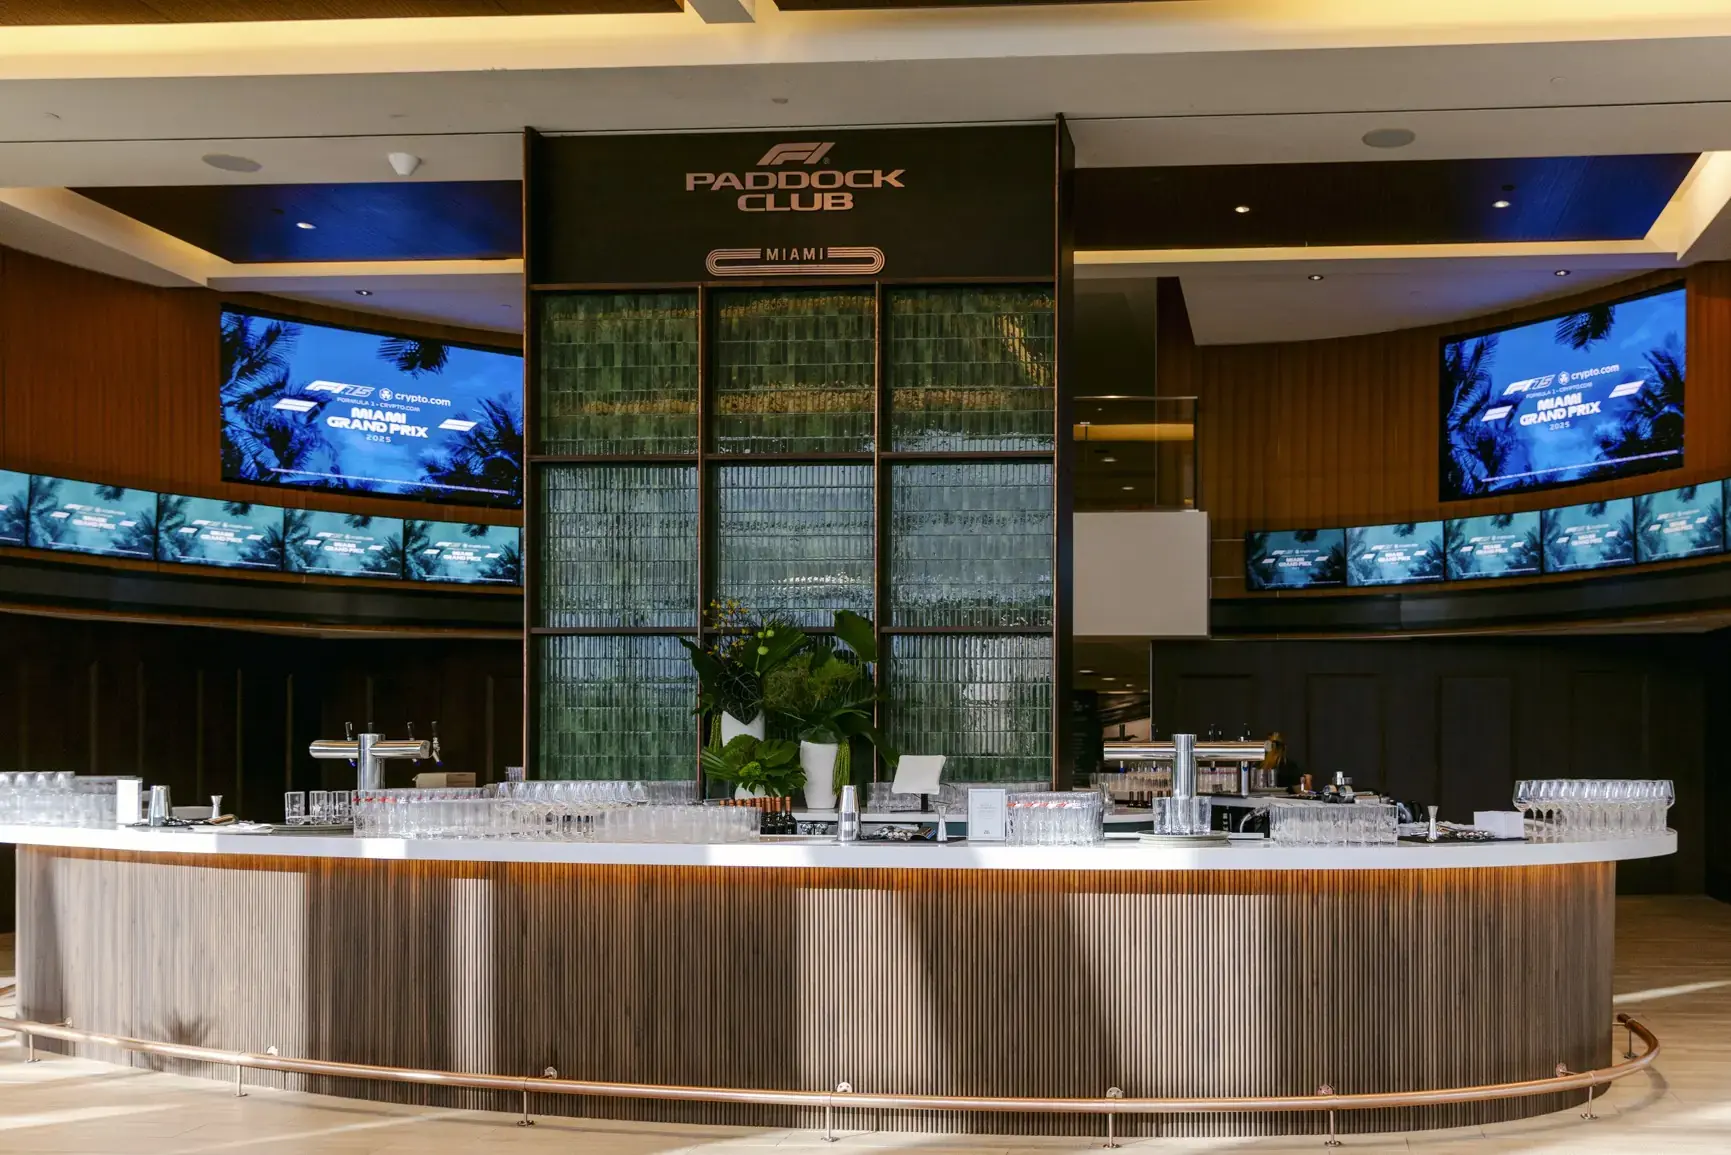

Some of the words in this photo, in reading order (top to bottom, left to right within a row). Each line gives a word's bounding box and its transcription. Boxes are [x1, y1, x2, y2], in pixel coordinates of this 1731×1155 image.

[685, 169, 907, 191] PADDOCK
[737, 192, 854, 212] CLUB
[766, 247, 824, 261] MIAMI
[1571, 364, 1620, 381] crypto.com
[395, 392, 451, 407] crypto.com
[1537, 392, 1582, 411] MIAMI
[351, 407, 406, 424] MIAMI
[1520, 408, 1567, 426] GRAND
[1567, 401, 1601, 418] PRIX
[327, 416, 388, 433] GRAND
[390, 423, 428, 438] PRIX
[1550, 421, 1570, 431] 2025
[366, 433, 391, 443] 2025
